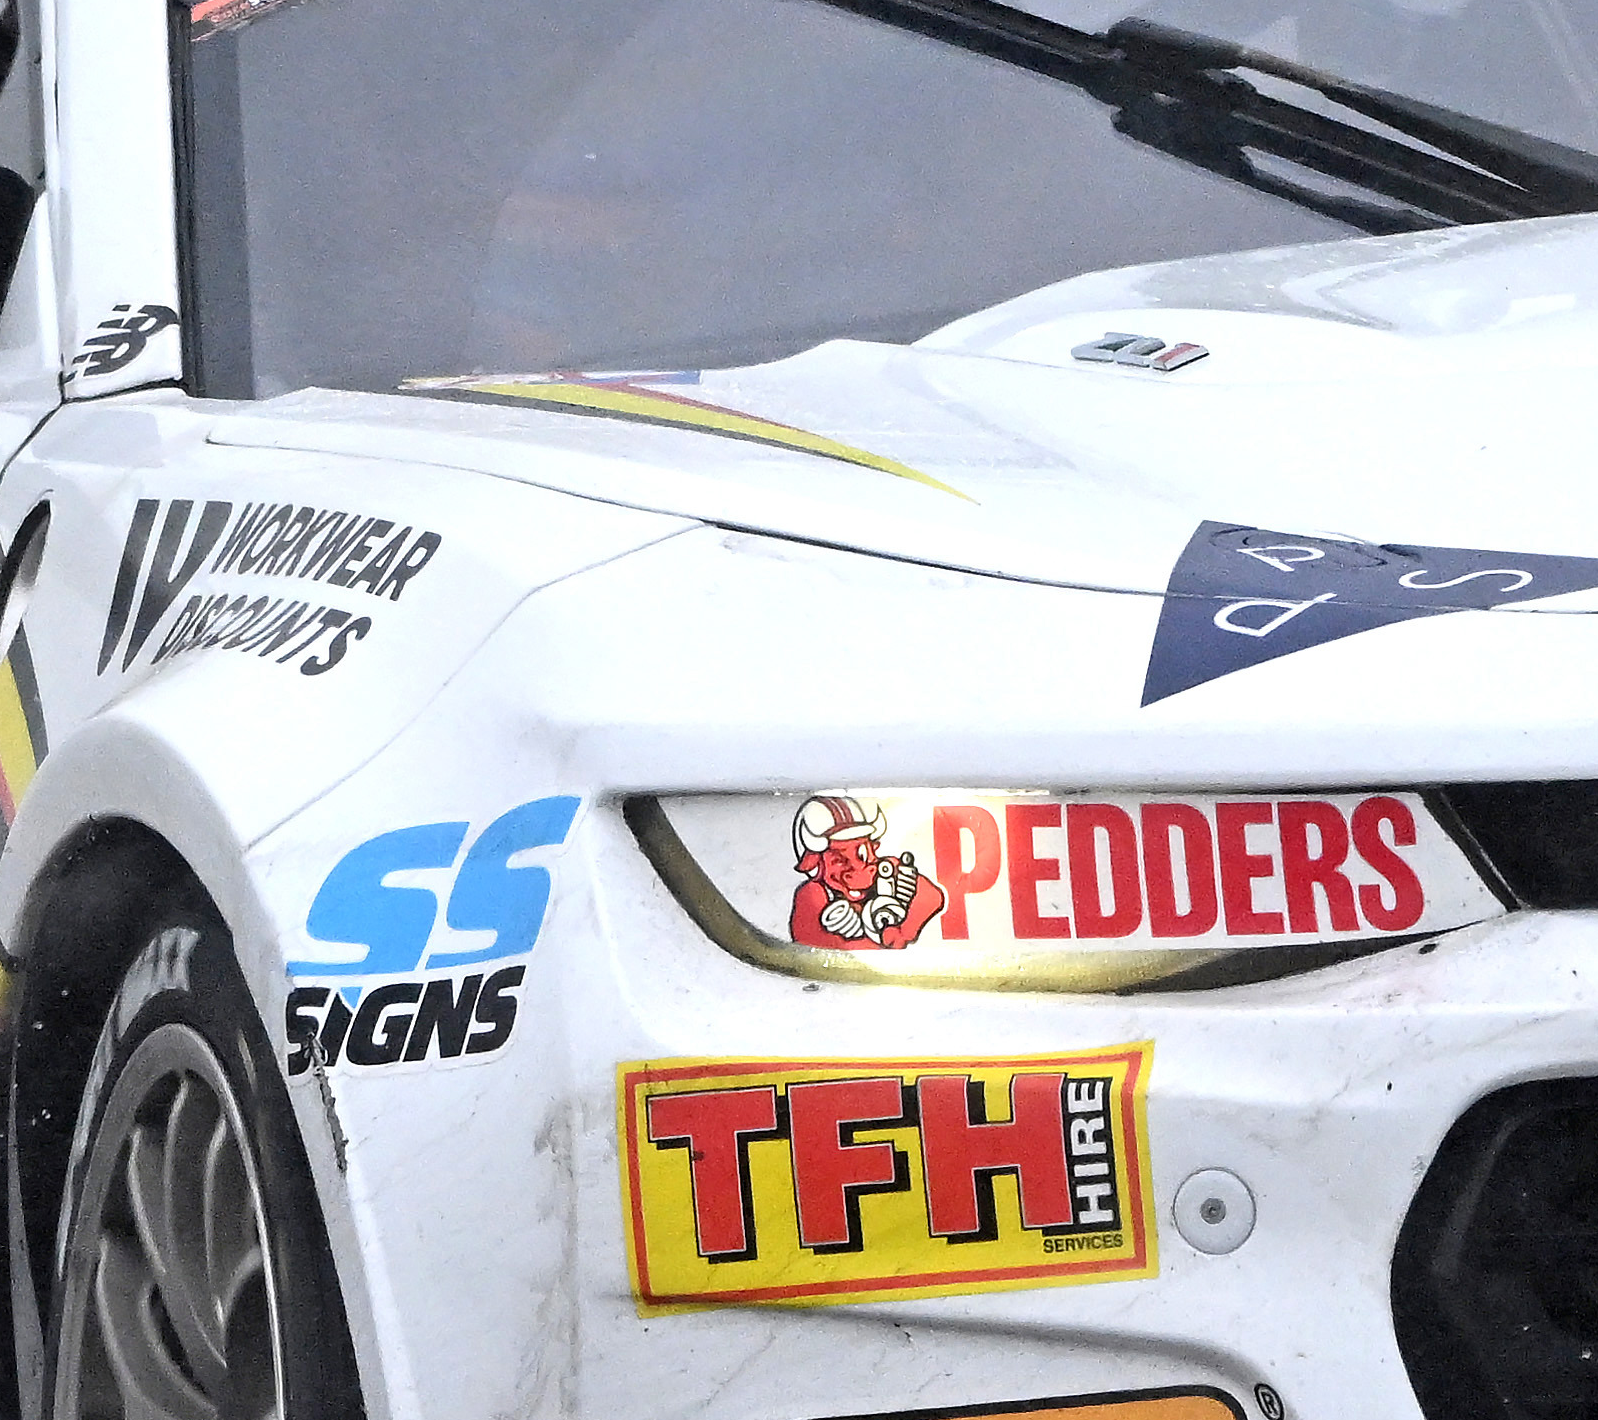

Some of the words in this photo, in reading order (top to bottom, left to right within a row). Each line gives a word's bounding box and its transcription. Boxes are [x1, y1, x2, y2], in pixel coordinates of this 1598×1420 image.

[209, 502, 443, 602] WORKWEAR
[151, 593, 372, 677] DISCOUNTS
[286, 795, 582, 977] SS
[932, 795, 1425, 941] PEDDERS
[286, 965, 526, 1077] SIGNS
[647, 1072, 1077, 1261] TFH
[1067, 1081, 1114, 1225] HIRE
[1043, 1233, 1123, 1254] SERVICES
